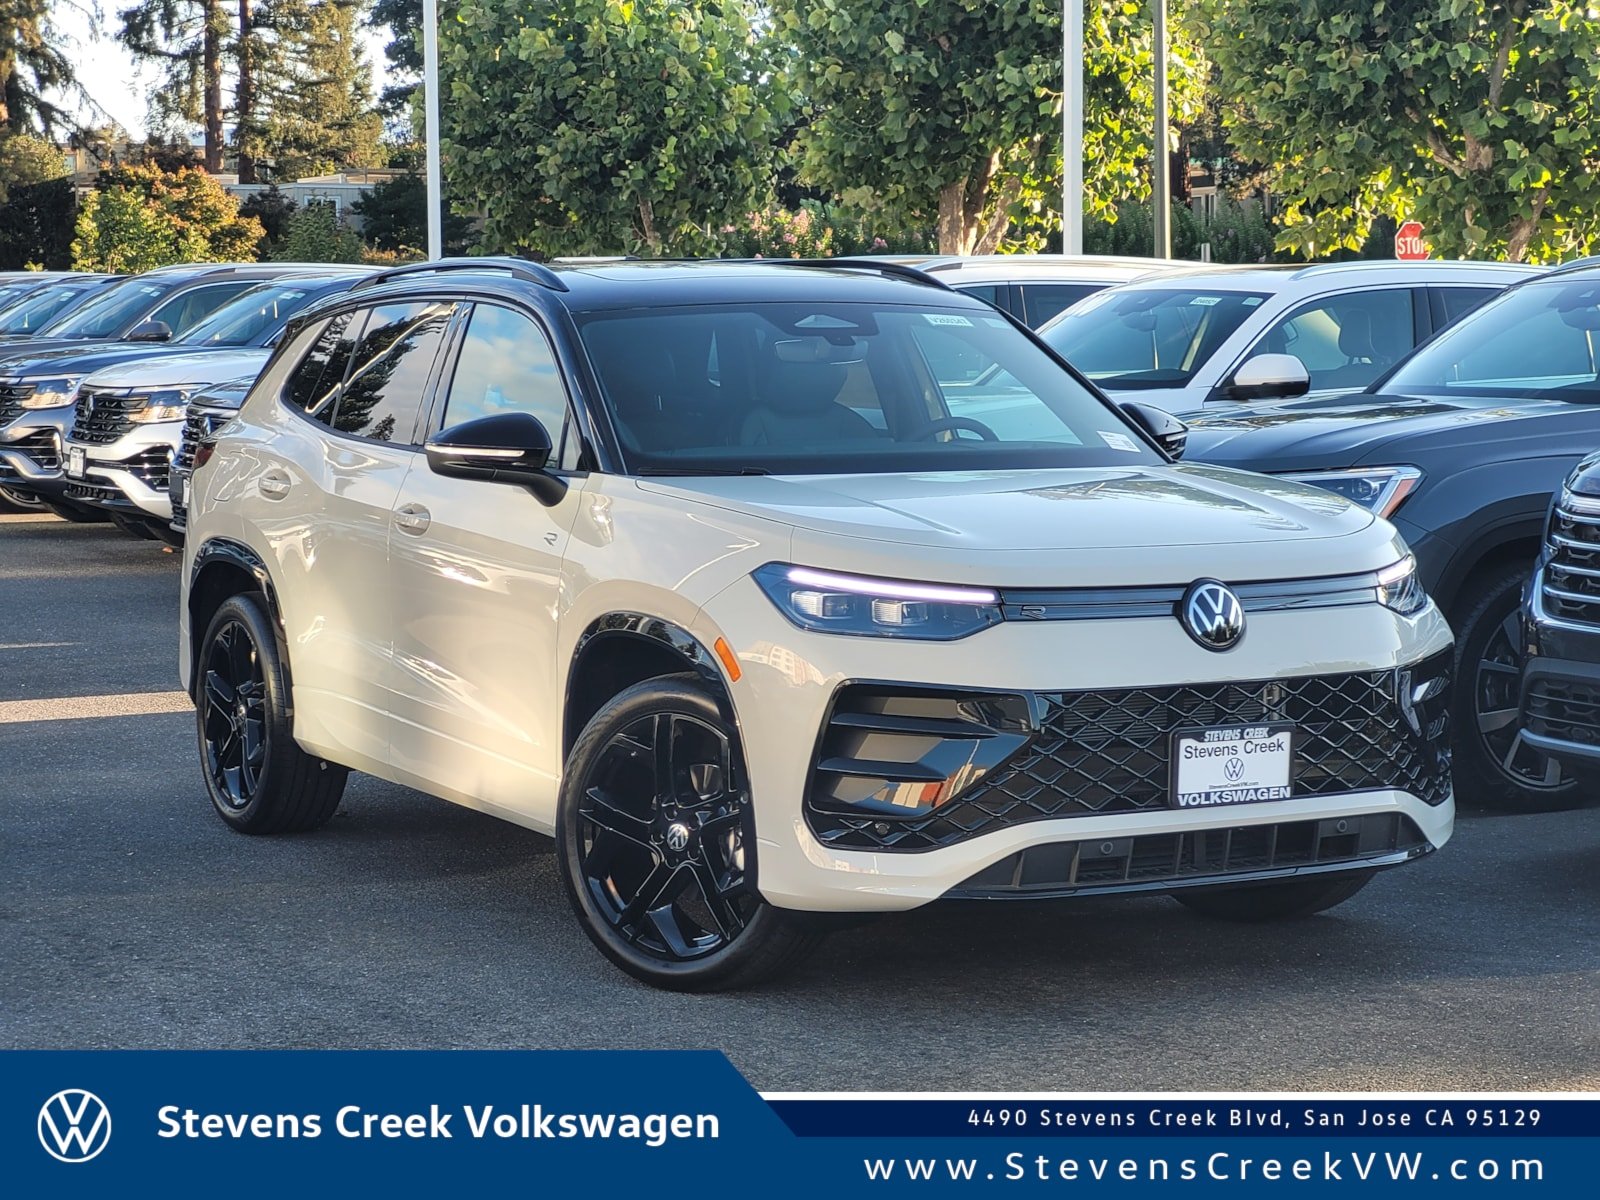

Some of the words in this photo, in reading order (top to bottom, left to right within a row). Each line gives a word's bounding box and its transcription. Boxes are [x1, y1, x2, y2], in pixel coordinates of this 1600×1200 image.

[1203, 729, 1241, 742] STEVENS
[1243, 727, 1270, 740] CREEK
[1184, 744, 1239, 760] Stevens
[1243, 738, 1285, 755] Creek
[1177, 786, 1291, 807] VOLKSWAGEN
